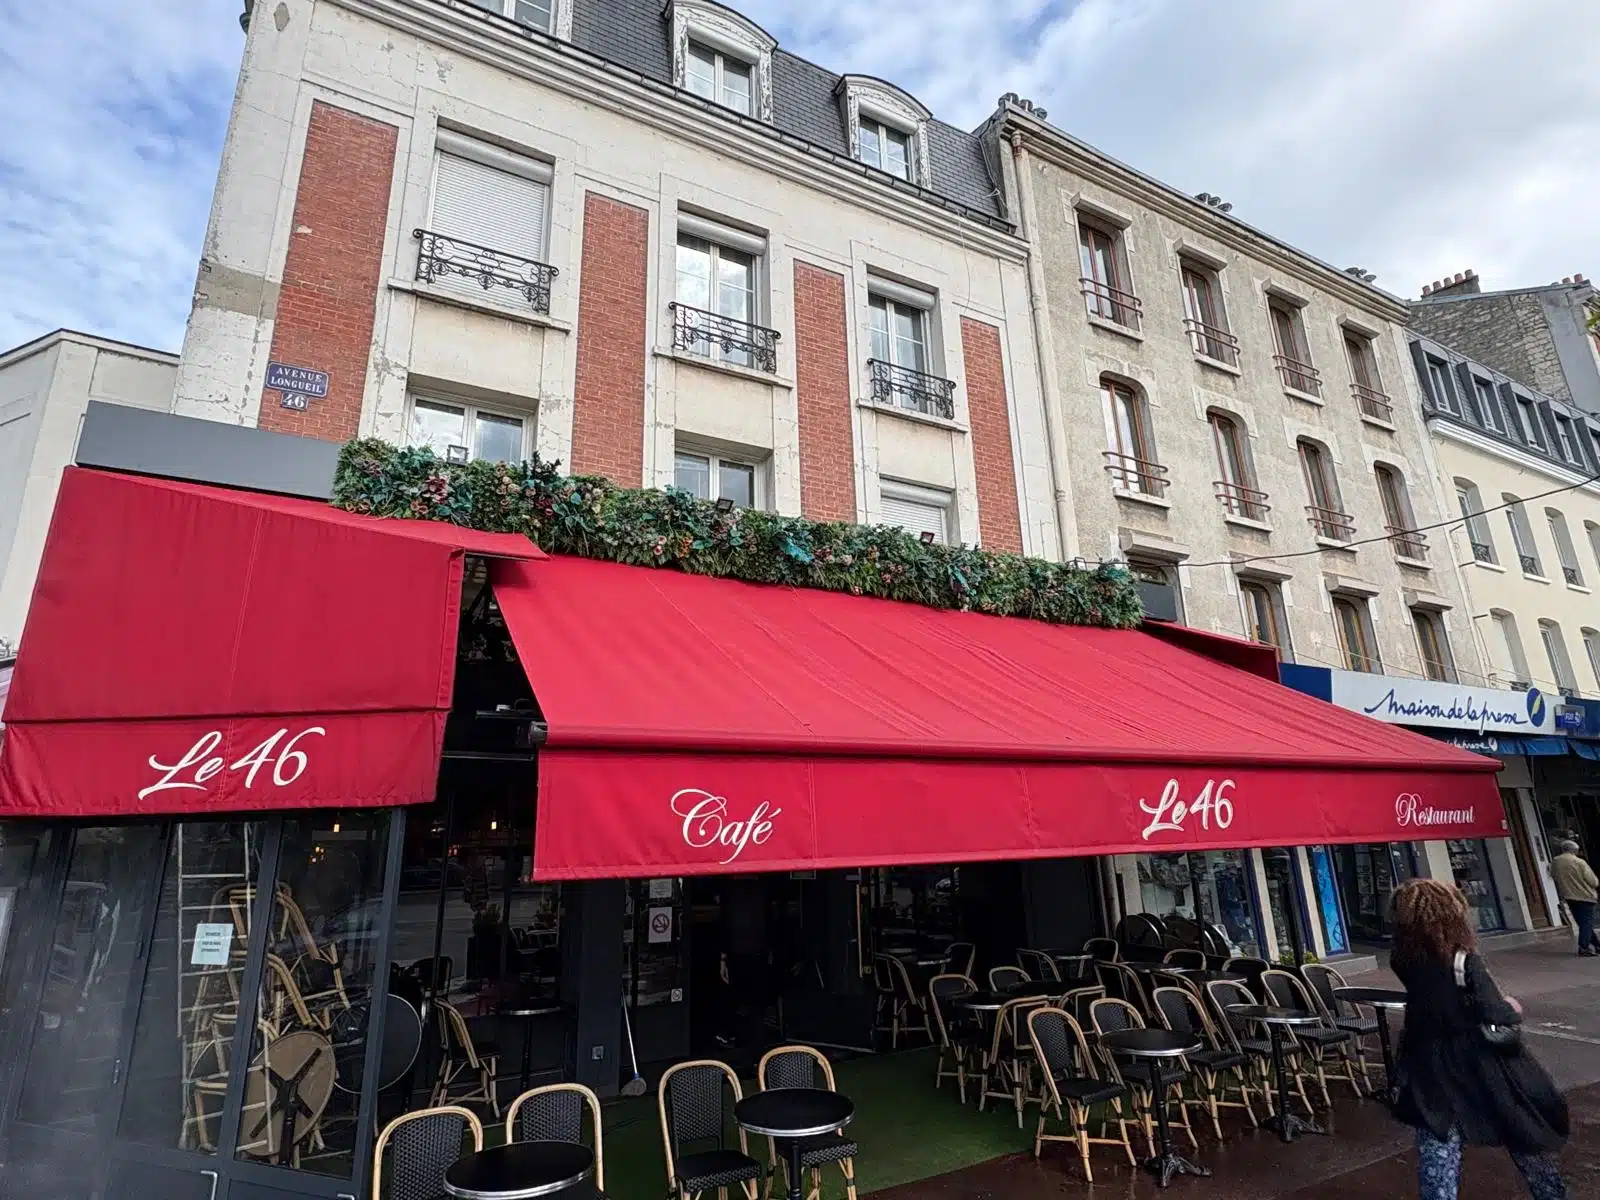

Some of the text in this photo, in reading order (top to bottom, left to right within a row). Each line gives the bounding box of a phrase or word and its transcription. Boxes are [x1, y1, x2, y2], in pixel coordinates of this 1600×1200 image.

[271, 376, 323, 394] LONGUEIL
[276, 367, 323, 383] AVENUE
[282, 394, 305, 408] 46
[137, 726, 326, 801] Le 46
[670, 788, 782, 865] Café
[1139, 778, 1236, 841] Le 46
[1395, 792, 1475, 827] Restaurant
